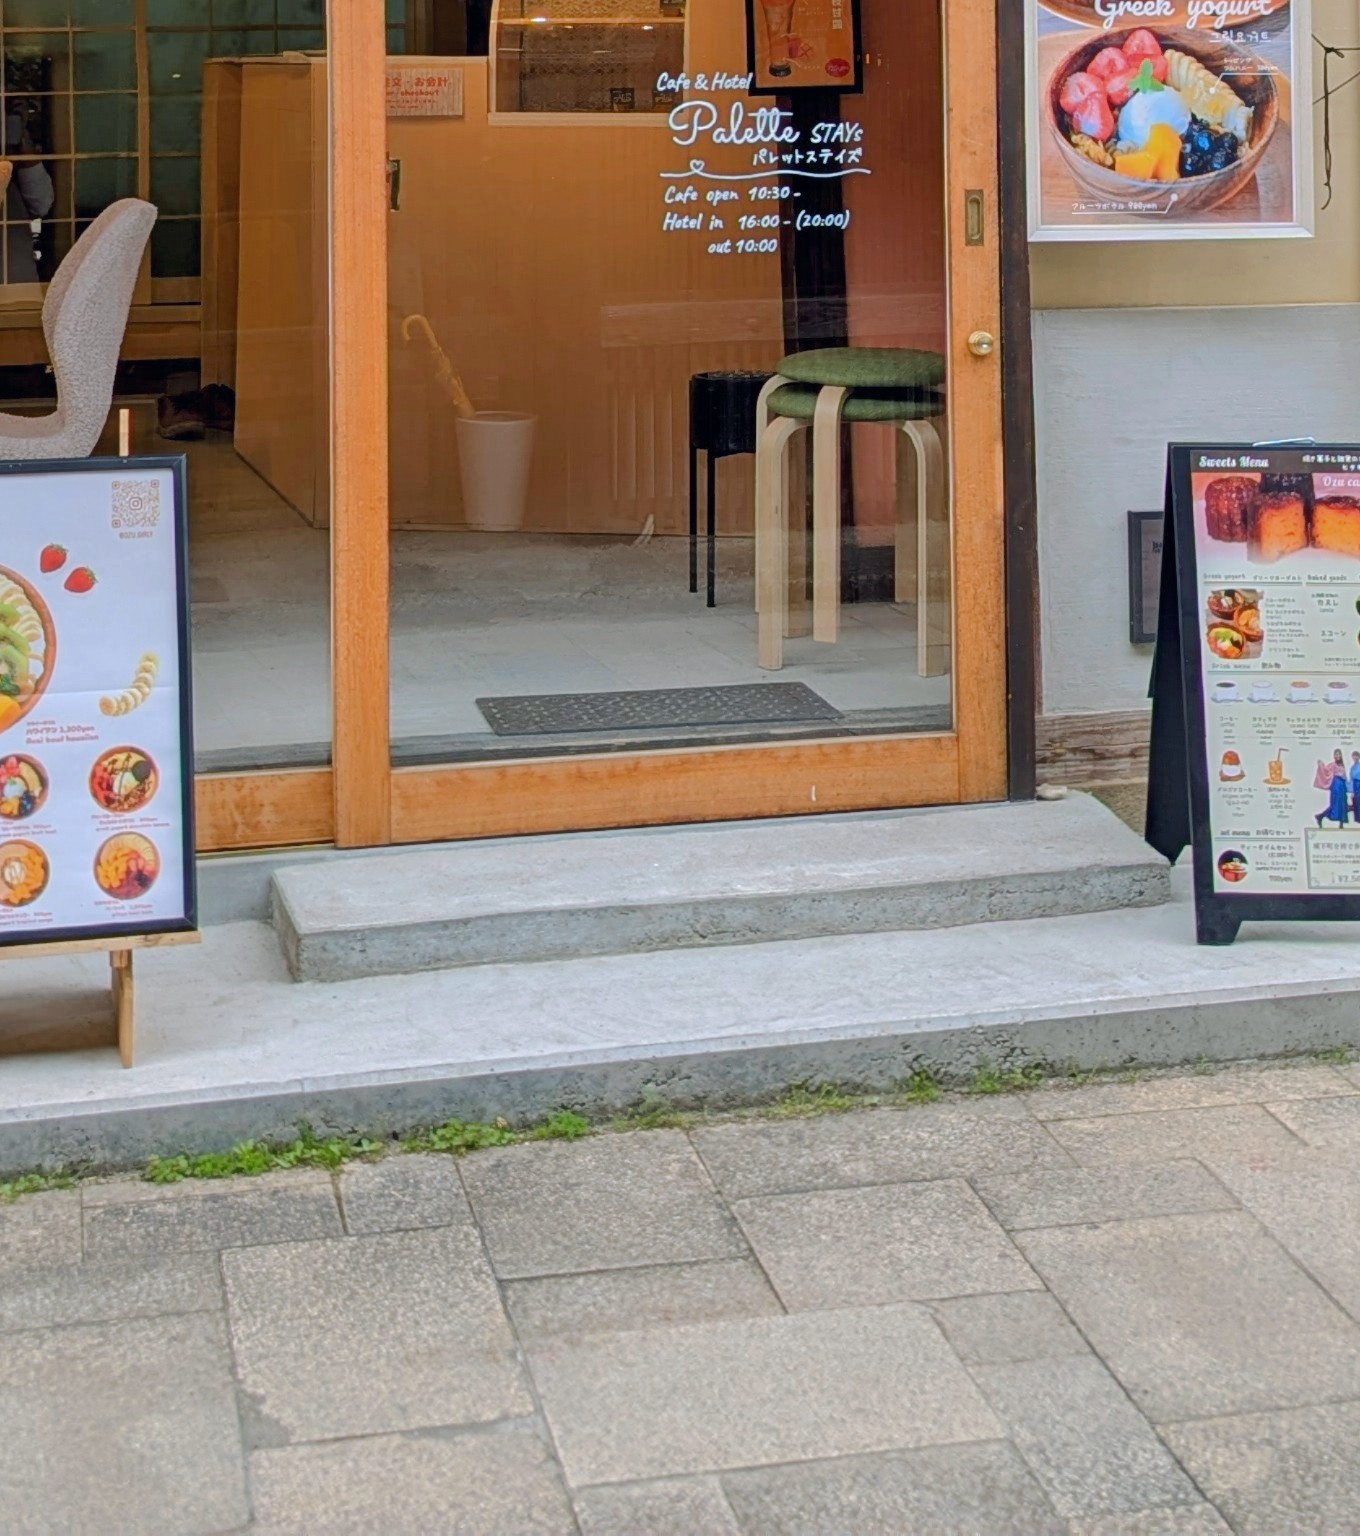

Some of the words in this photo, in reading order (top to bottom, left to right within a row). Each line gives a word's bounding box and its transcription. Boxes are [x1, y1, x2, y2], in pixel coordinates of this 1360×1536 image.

[657, 72, 690, 92] Cafe
[695, 75, 709, 91] &
[711, 72, 753, 92] Hotel
[668, 100, 800, 145] Palette
[810, 121, 863, 144] STAYs
[753, 147, 863, 166] パレットステイズ
[664, 185, 698, 204] Cafe
[706, 189, 739, 206] open
[662, 211, 703, 231] Hotel
[709, 214, 723, 229] in
[708, 239, 731, 253] out
[736, 238, 778, 253] 10:00
[1199, 455, 1237, 468] Sweets
[1239, 455, 1270, 468] Menu
[1323, 475, 1345, 488] Ozu
